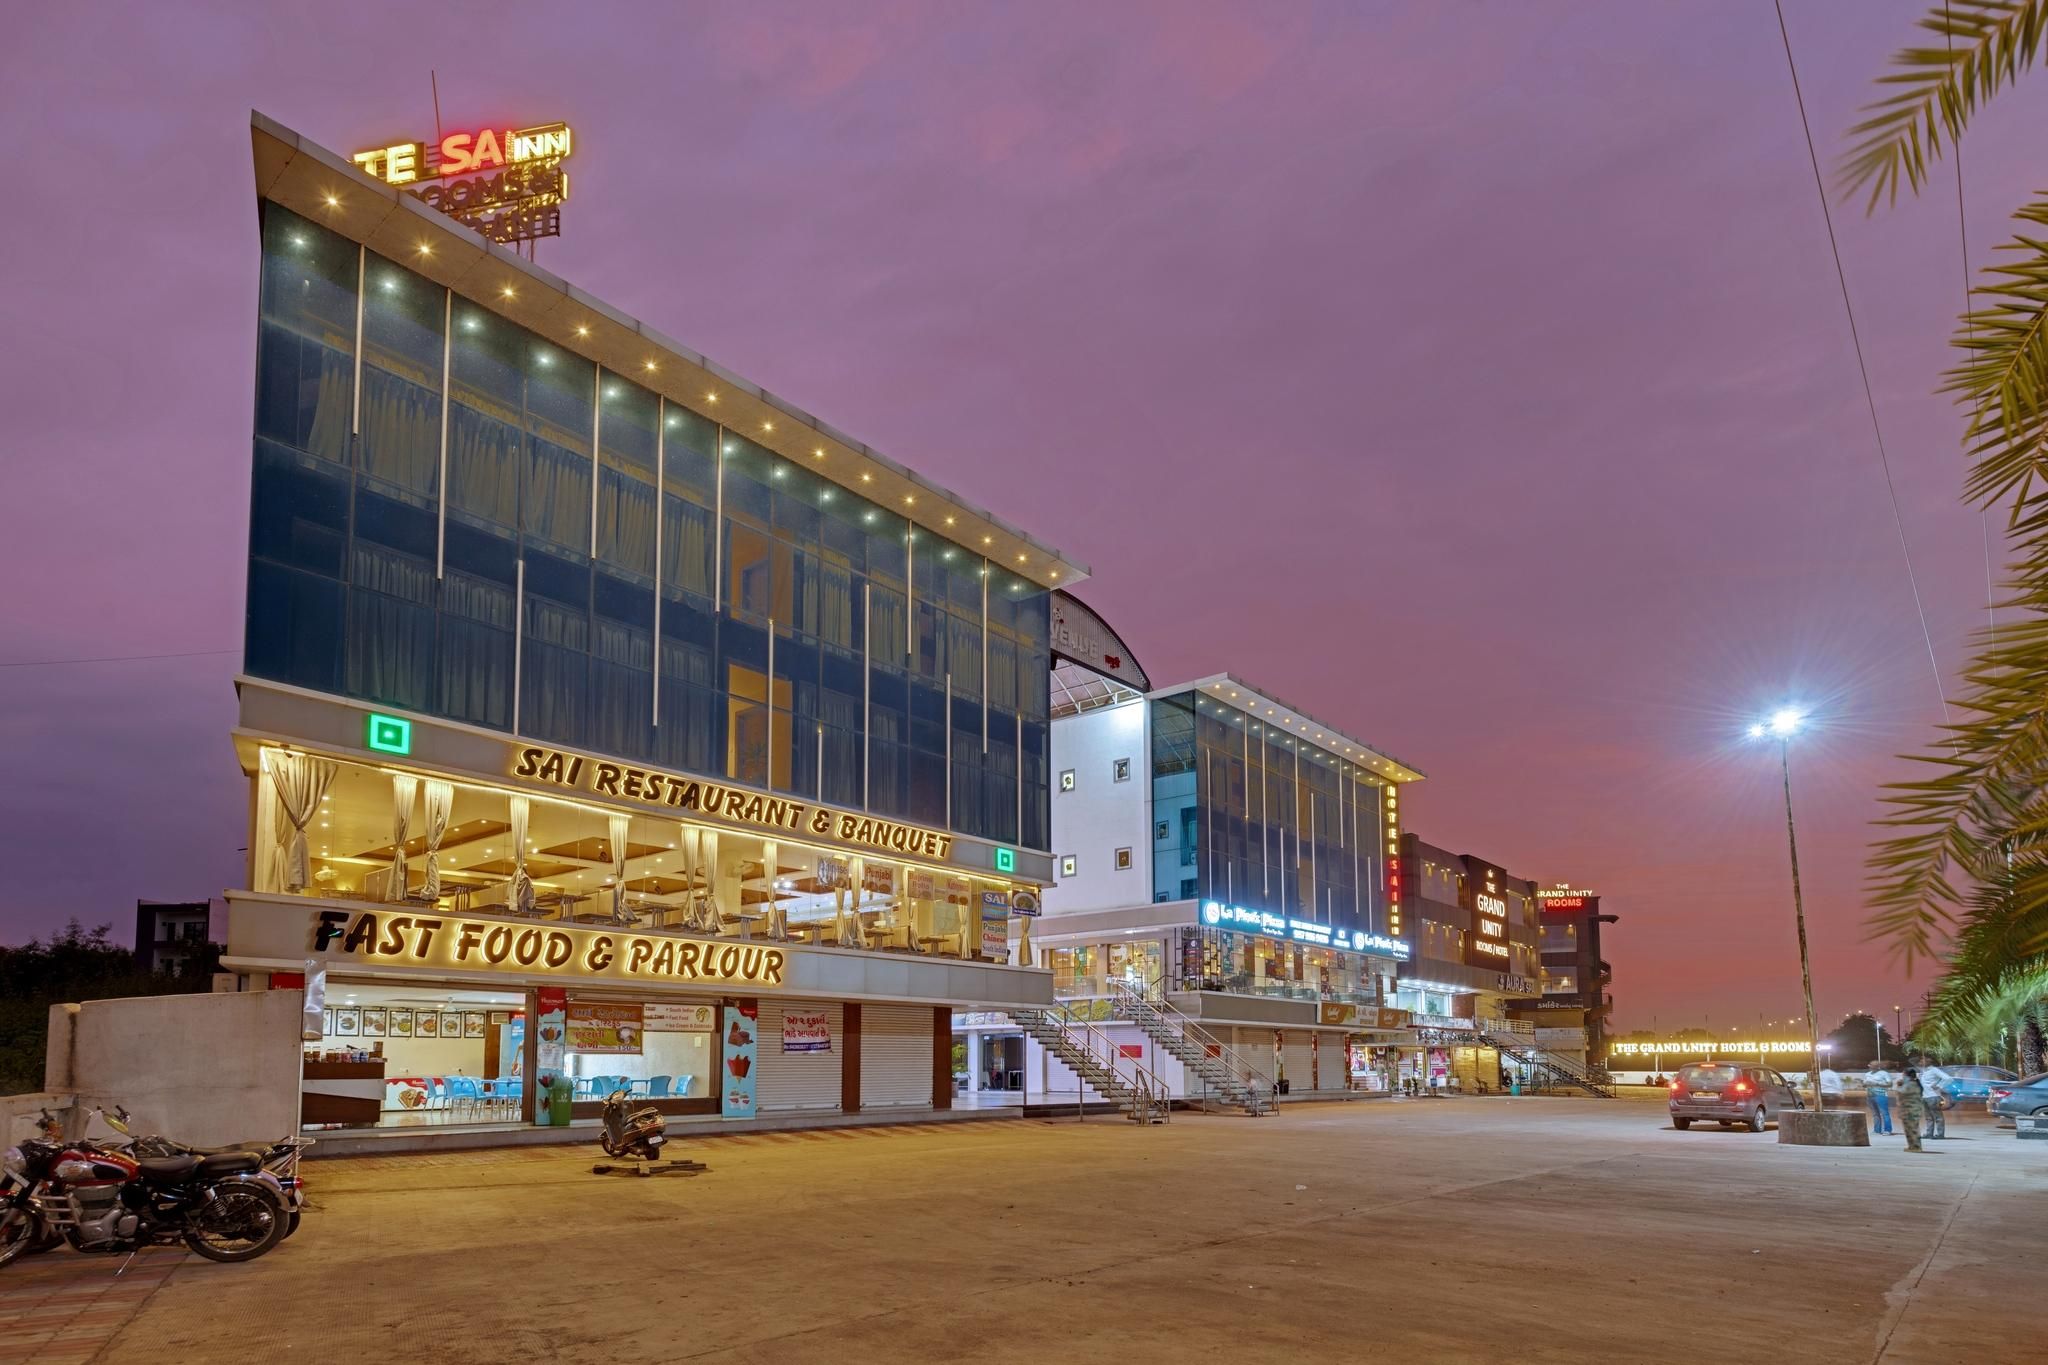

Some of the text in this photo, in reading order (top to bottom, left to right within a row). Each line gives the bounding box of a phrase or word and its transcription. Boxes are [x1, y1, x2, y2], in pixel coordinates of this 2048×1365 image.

[514, 132, 566, 162] INN
[514, 747, 951, 857] SAI RESTAURANT & BANQUET
[1486, 881, 1496, 893] THE
[1566, 889, 1593, 897] UNITY
[985, 893, 1005, 904] SAI
[1477, 895, 1505, 917] GRAND
[1547, 898, 1582, 907] ROOMS
[1482, 918, 1502, 938] UNITY
[983, 933, 1007, 944] Chinese
[313, 911, 785, 985] FAST FOOD & PARLOUR
[1506, 975, 1524, 993] AURA
[1616, 1043, 1638, 1053] THE
[1640, 1042, 1681, 1053] GRAND
[1681, 1042, 1718, 1053] UNITY
[1720, 1042, 1759, 1053] HOTEL
[1772, 1042, 1812, 1053] ROOMS
